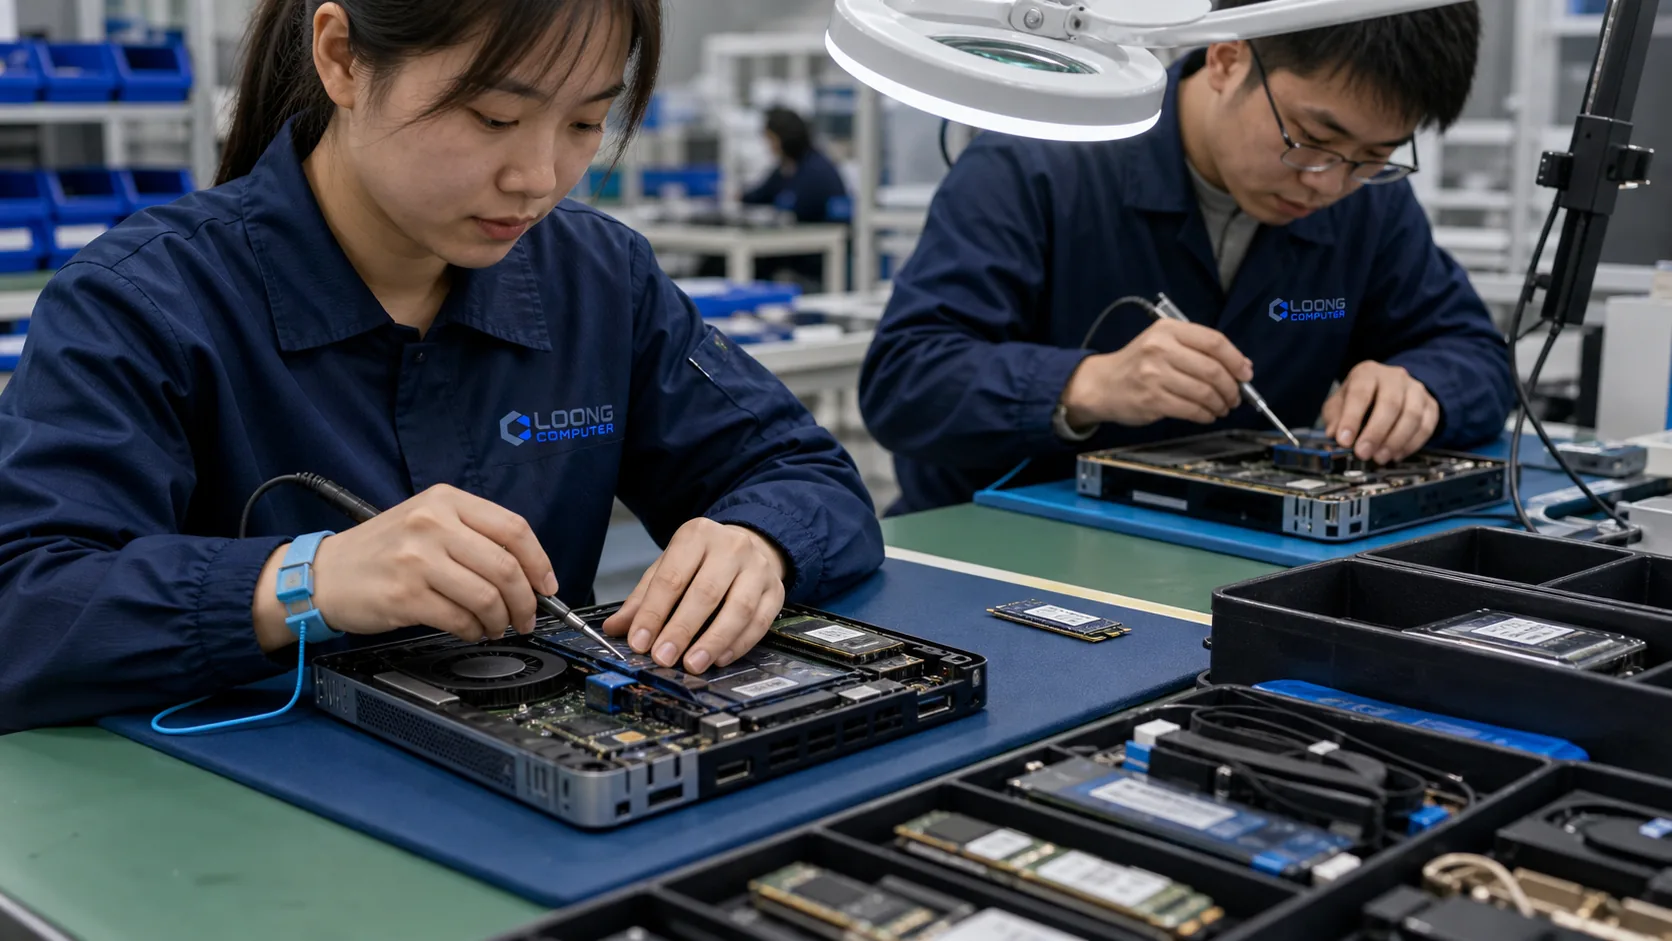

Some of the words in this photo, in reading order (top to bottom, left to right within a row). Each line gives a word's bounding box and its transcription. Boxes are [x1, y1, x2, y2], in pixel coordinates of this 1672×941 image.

[1290, 298, 1346, 312] LOONG
[1290, 310, 1345, 321] COMPUTER
[533, 405, 613, 430] LOONG
[536, 423, 614, 442] COMPUTER
